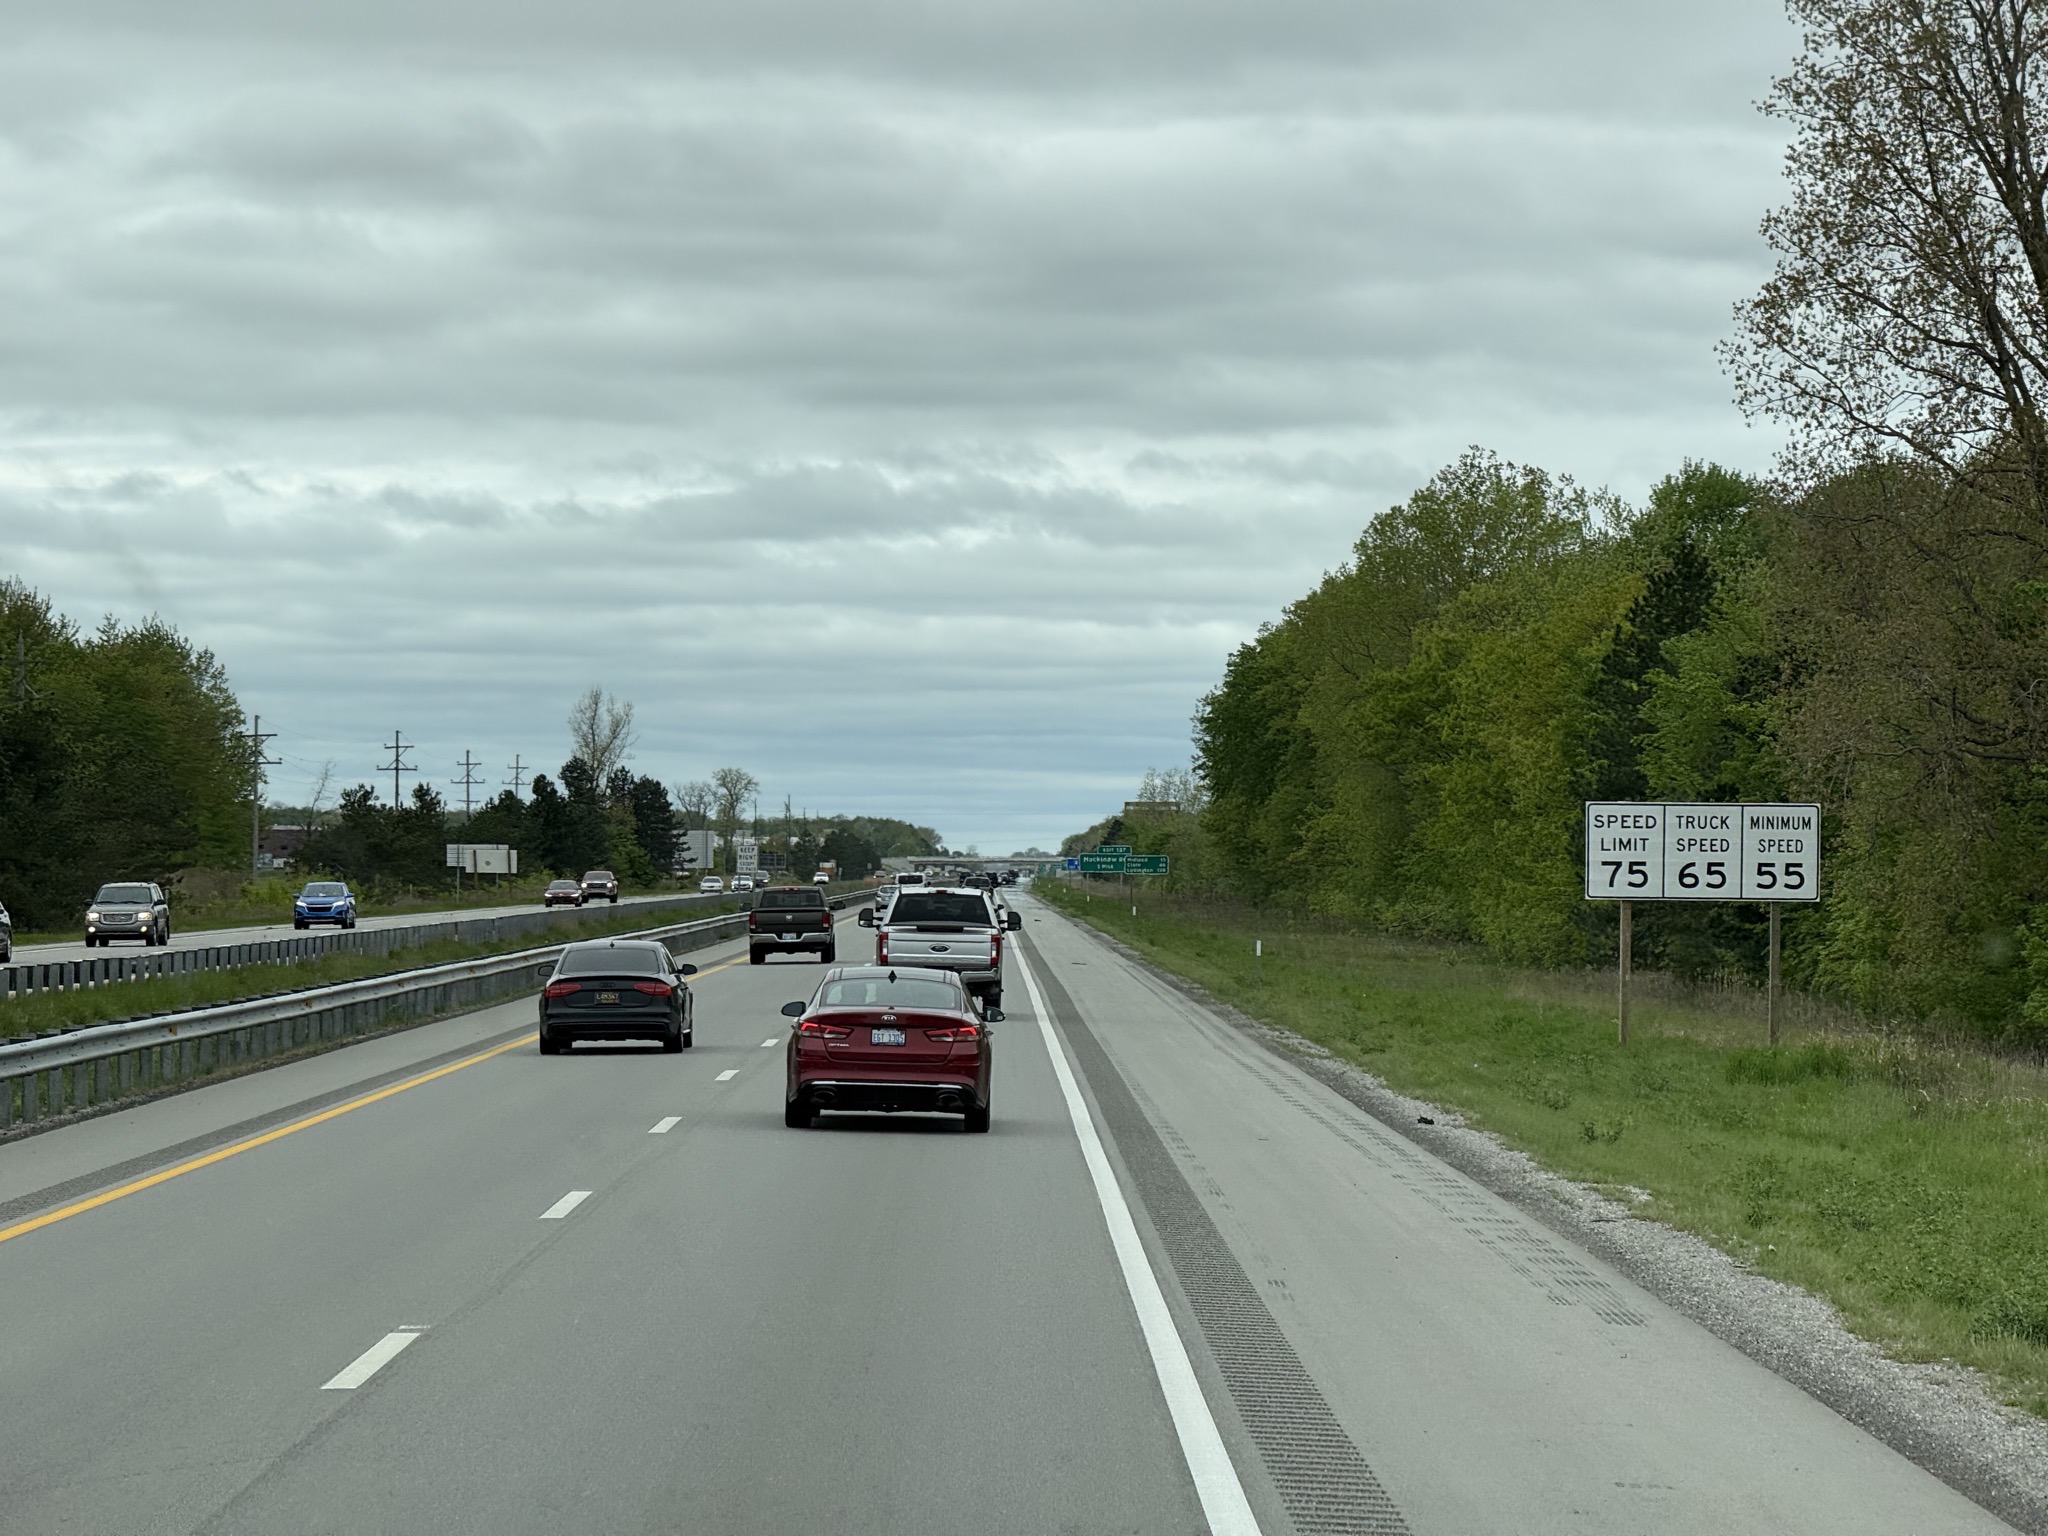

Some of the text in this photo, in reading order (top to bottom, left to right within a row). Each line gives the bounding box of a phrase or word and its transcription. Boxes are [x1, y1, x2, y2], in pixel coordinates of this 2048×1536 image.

[1593, 814, 1658, 829] SPEED
[1675, 815, 1731, 830] TRUCK
[1750, 816, 1812, 831] MINIMUM
[1600, 837, 1650, 852] LIMIT
[1676, 838, 1731, 853] SPEED
[1757, 839, 1804, 854] SPEED
[1601, 860, 1649, 889] 75
[1678, 861, 1727, 890] 65
[1755, 862, 1806, 890] 55
